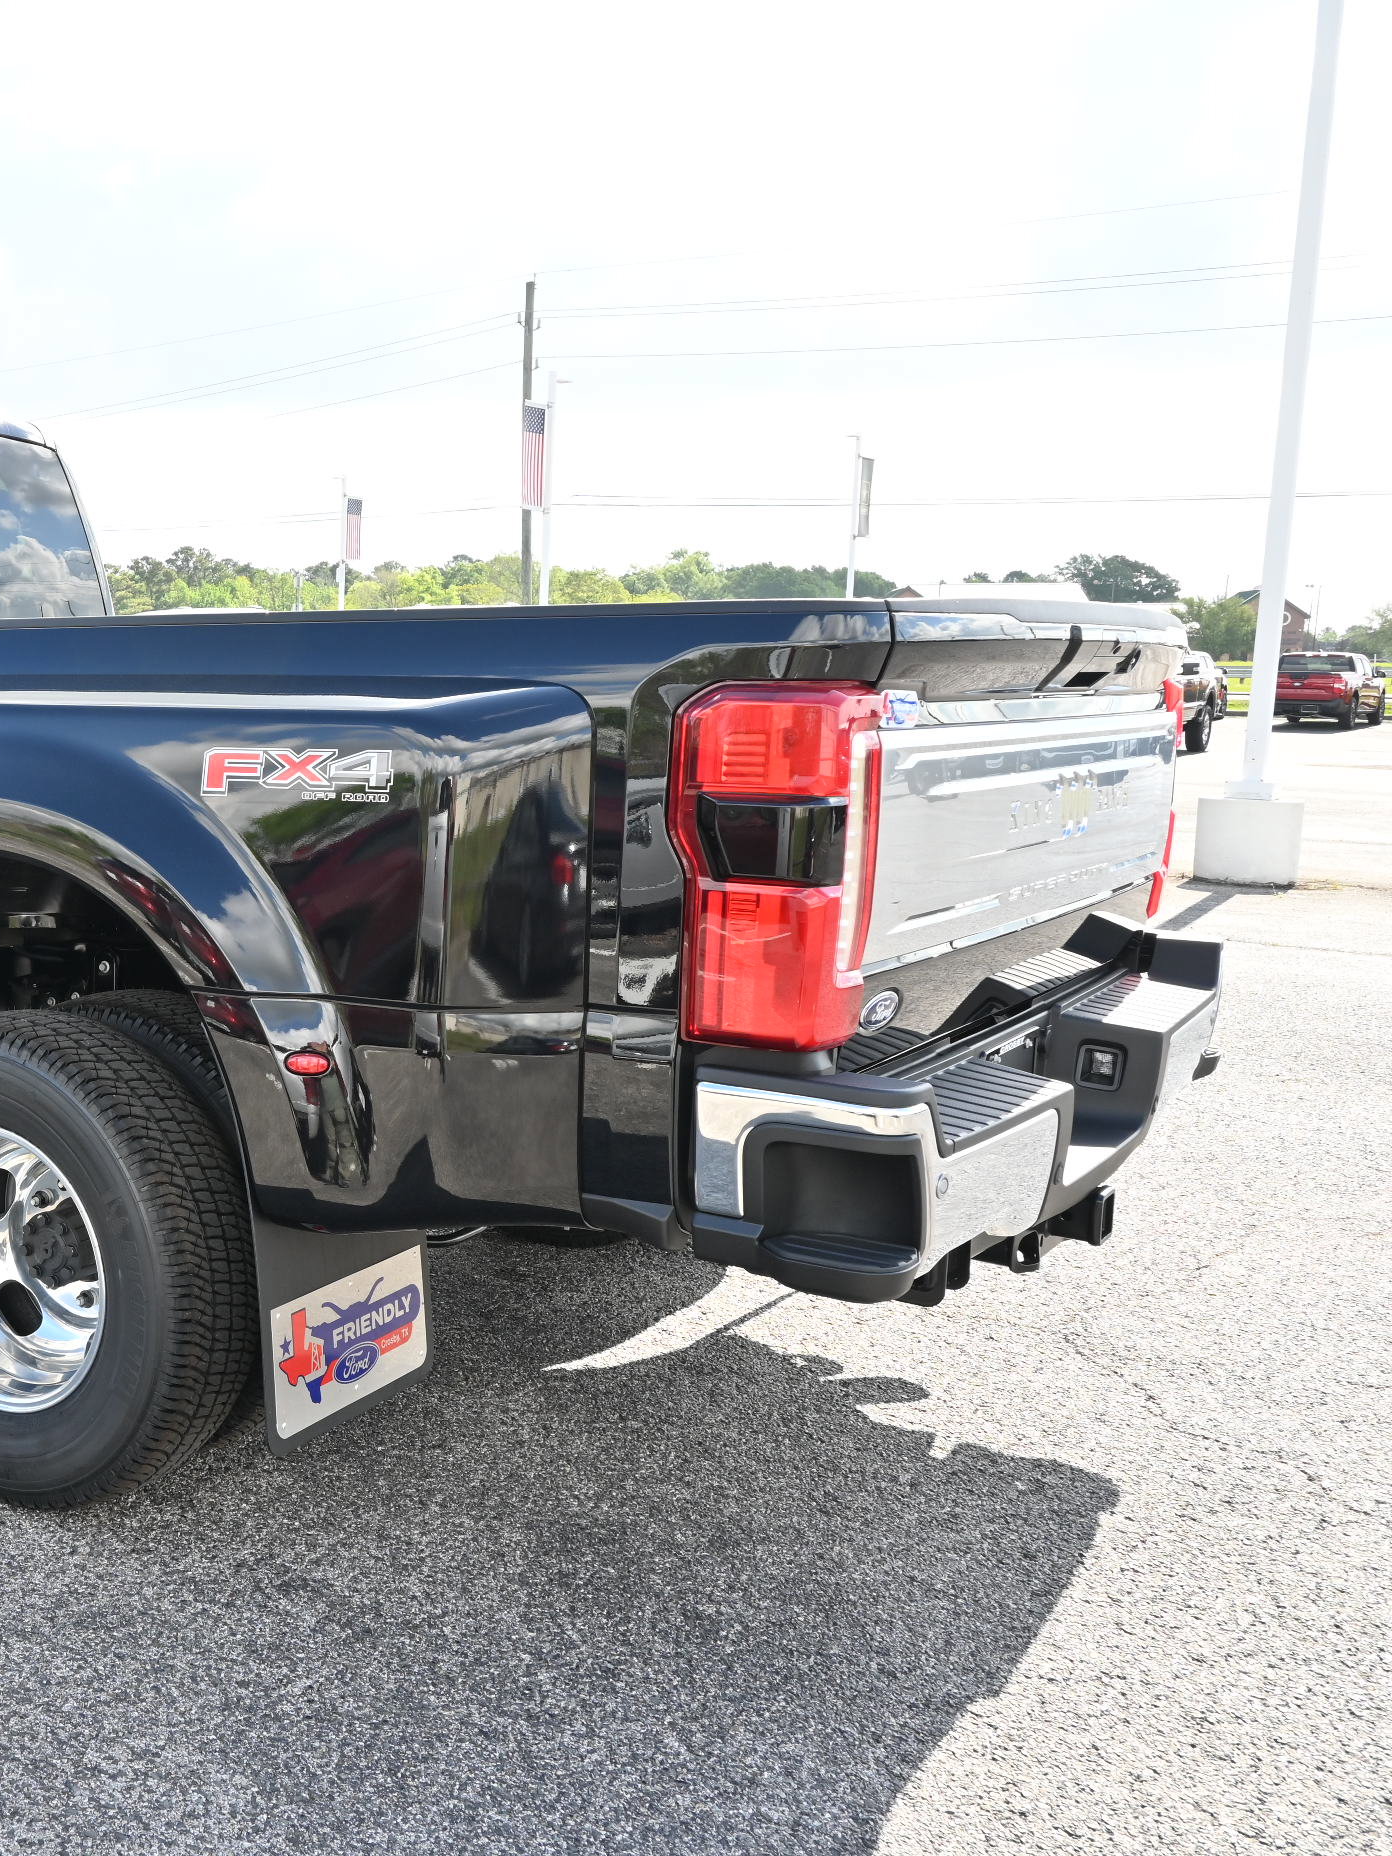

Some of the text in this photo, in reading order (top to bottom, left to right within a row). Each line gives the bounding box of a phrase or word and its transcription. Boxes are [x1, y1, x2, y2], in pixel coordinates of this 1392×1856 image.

[201, 747, 393, 796] FX4
[301, 791, 390, 803] OFF ROAD
[332, 1293, 412, 1349] FRIENDLY
[343, 1352, 371, 1379] Ford
